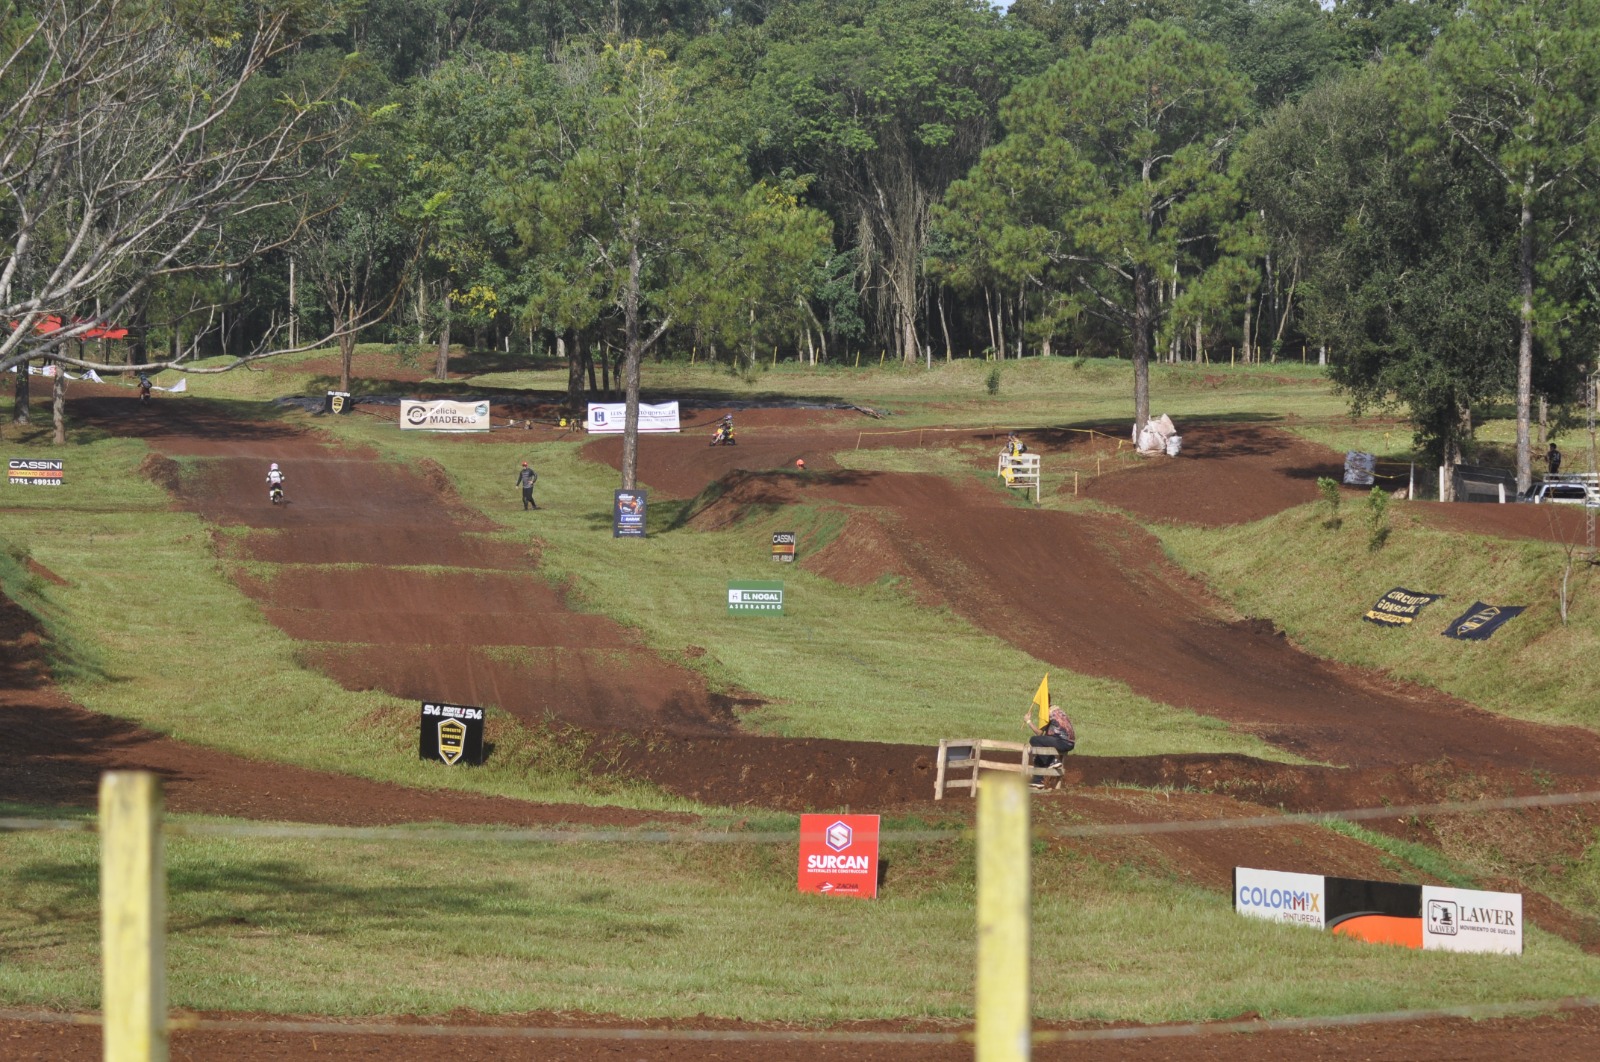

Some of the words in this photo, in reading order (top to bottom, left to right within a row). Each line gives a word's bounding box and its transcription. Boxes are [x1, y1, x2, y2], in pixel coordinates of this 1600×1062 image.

[429, 416, 477, 424] MADERAS
[9, 460, 63, 470] CASSINI
[751, 593, 779, 601] NOGAL
[807, 854, 869, 869] SURCAN
[1240, 885, 1320, 912] COLORMIX
[1283, 912, 1321, 923] PINTURERIA
[1460, 906, 1515, 926] LAWER
[1430, 924, 1455, 934] LAWER
[1460, 924, 1490, 933] MOVIMIENTO
